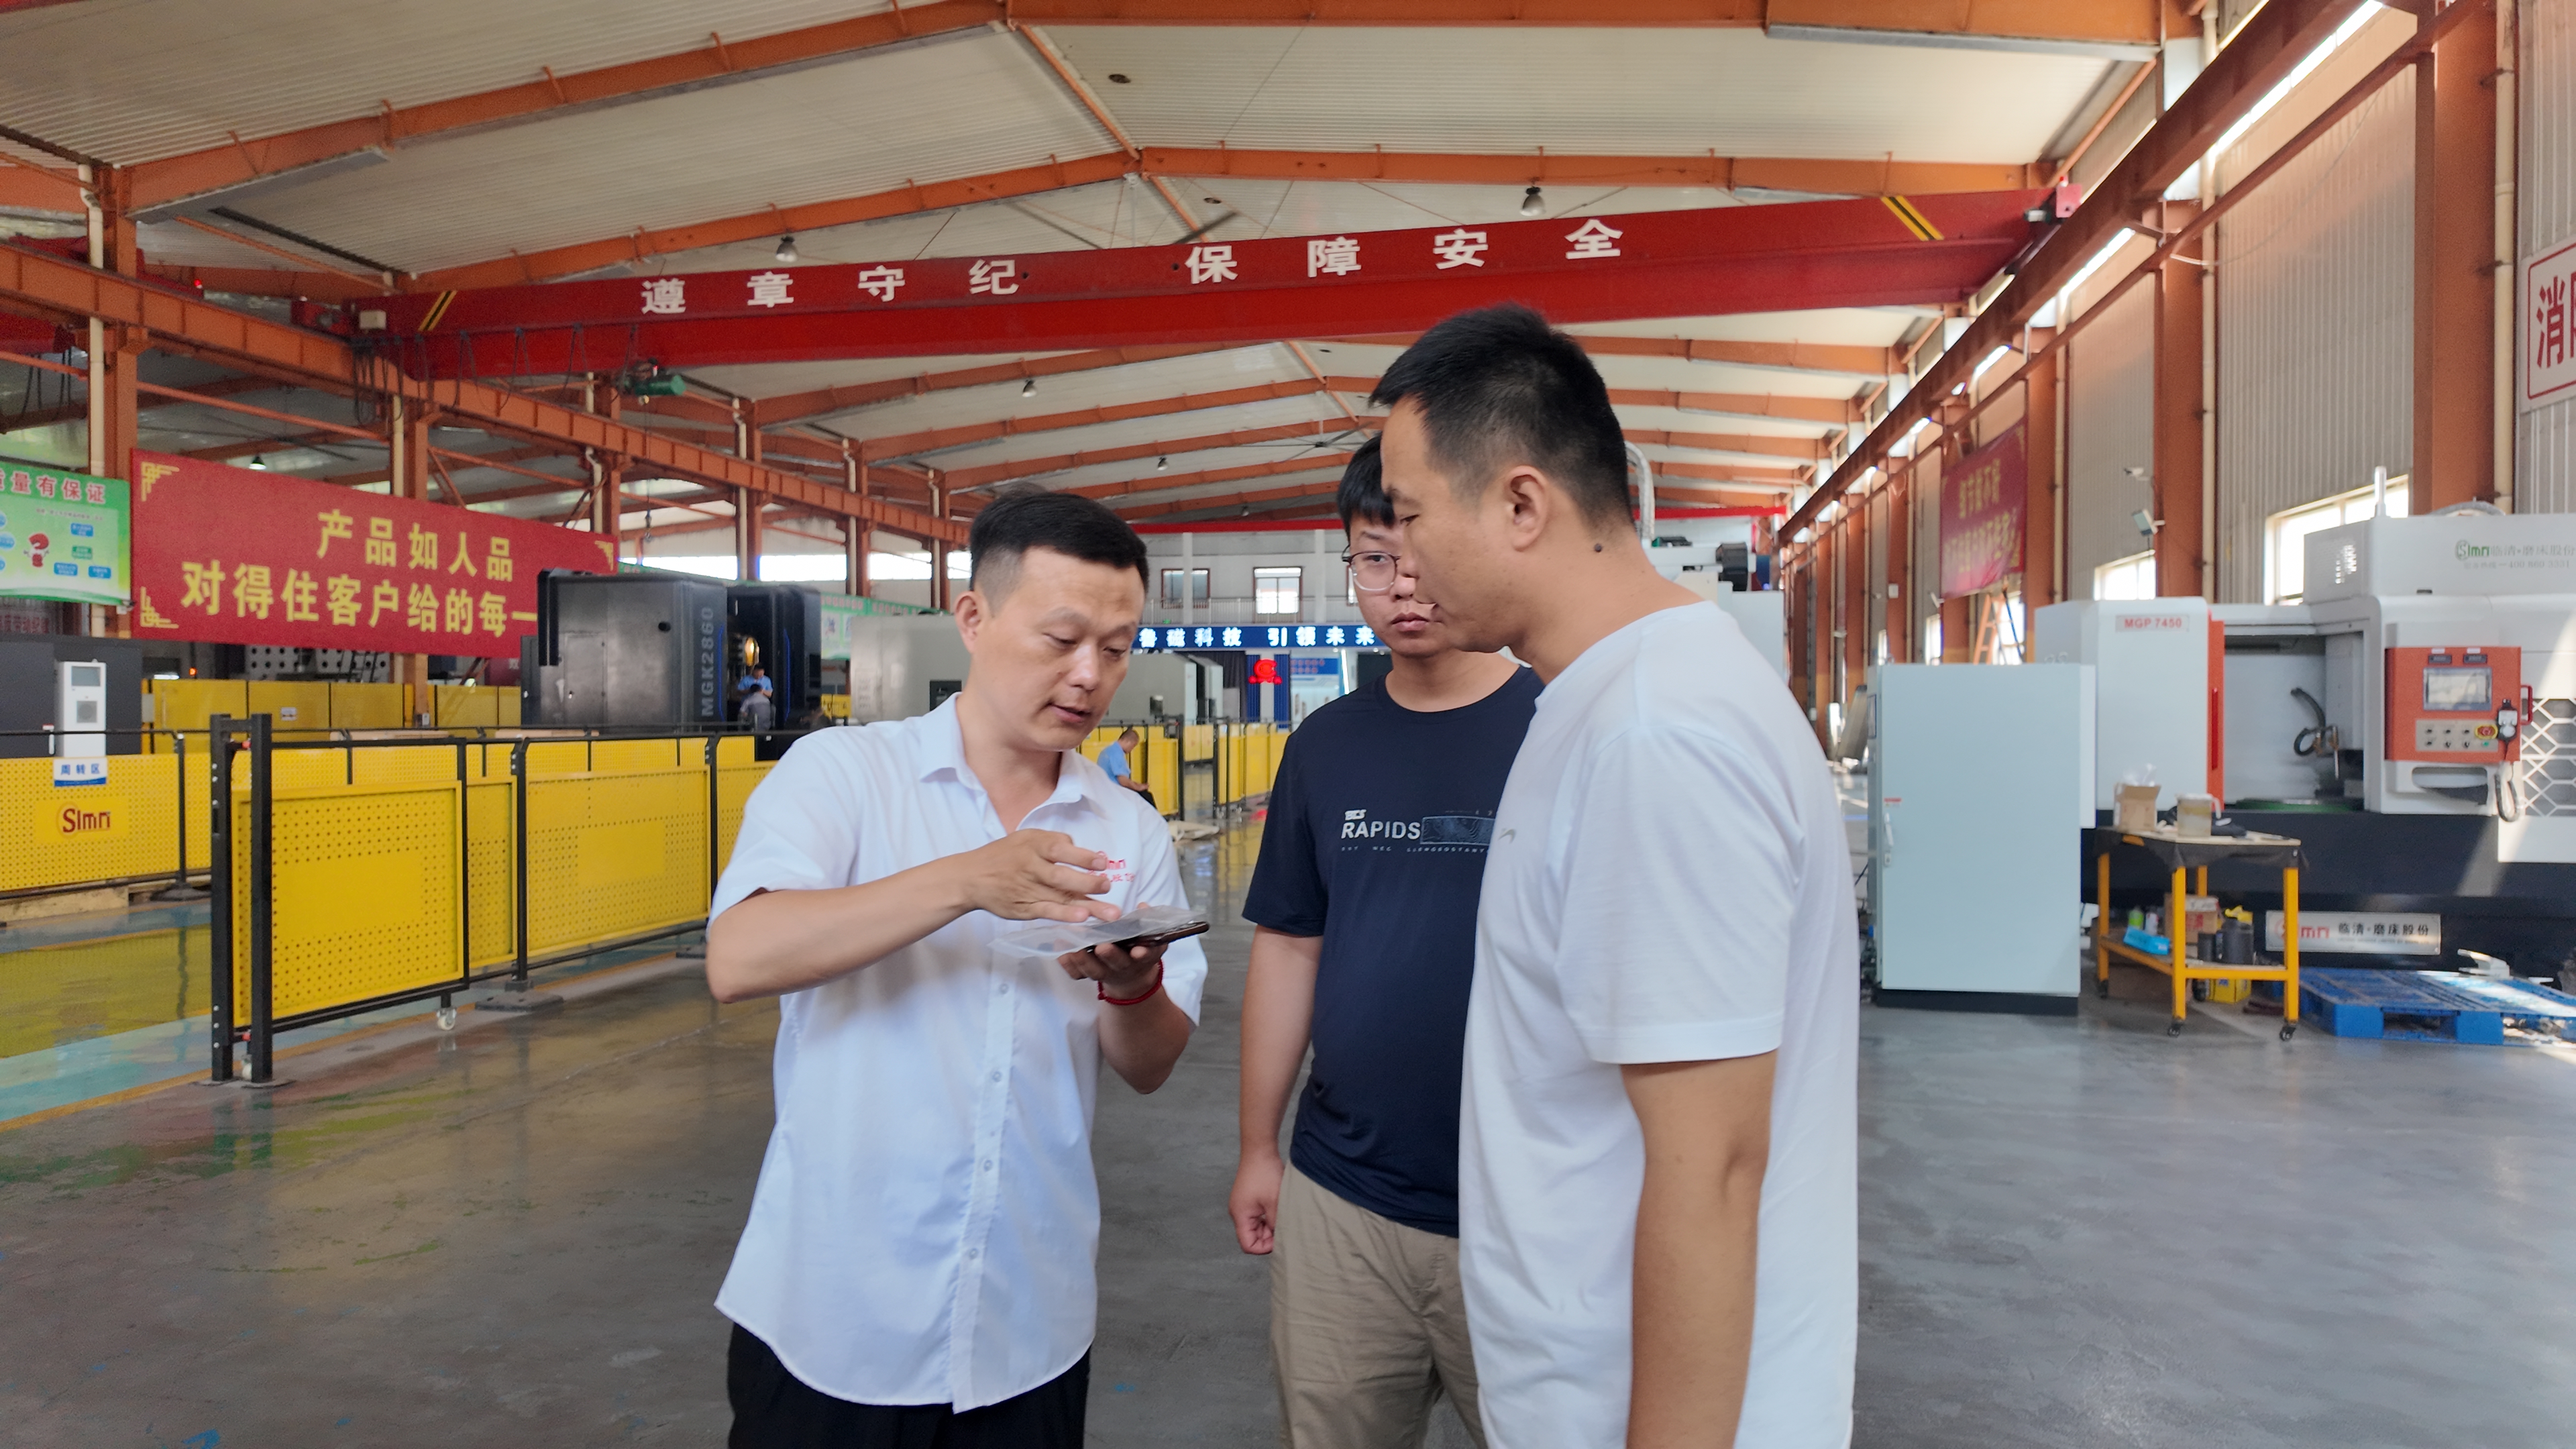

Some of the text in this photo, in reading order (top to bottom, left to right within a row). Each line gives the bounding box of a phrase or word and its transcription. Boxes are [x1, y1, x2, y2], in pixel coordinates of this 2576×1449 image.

[641, 219, 1623, 314] 遵章守纪 保障安全
[317, 509, 513, 582] 产品如人品
[1267, 626, 1375, 646] 引领未来
[2124, 617, 2182, 629] MGP 7450
[701, 607, 714, 716] MGK2860
[1341, 820, 1421, 840] RAPIDS
